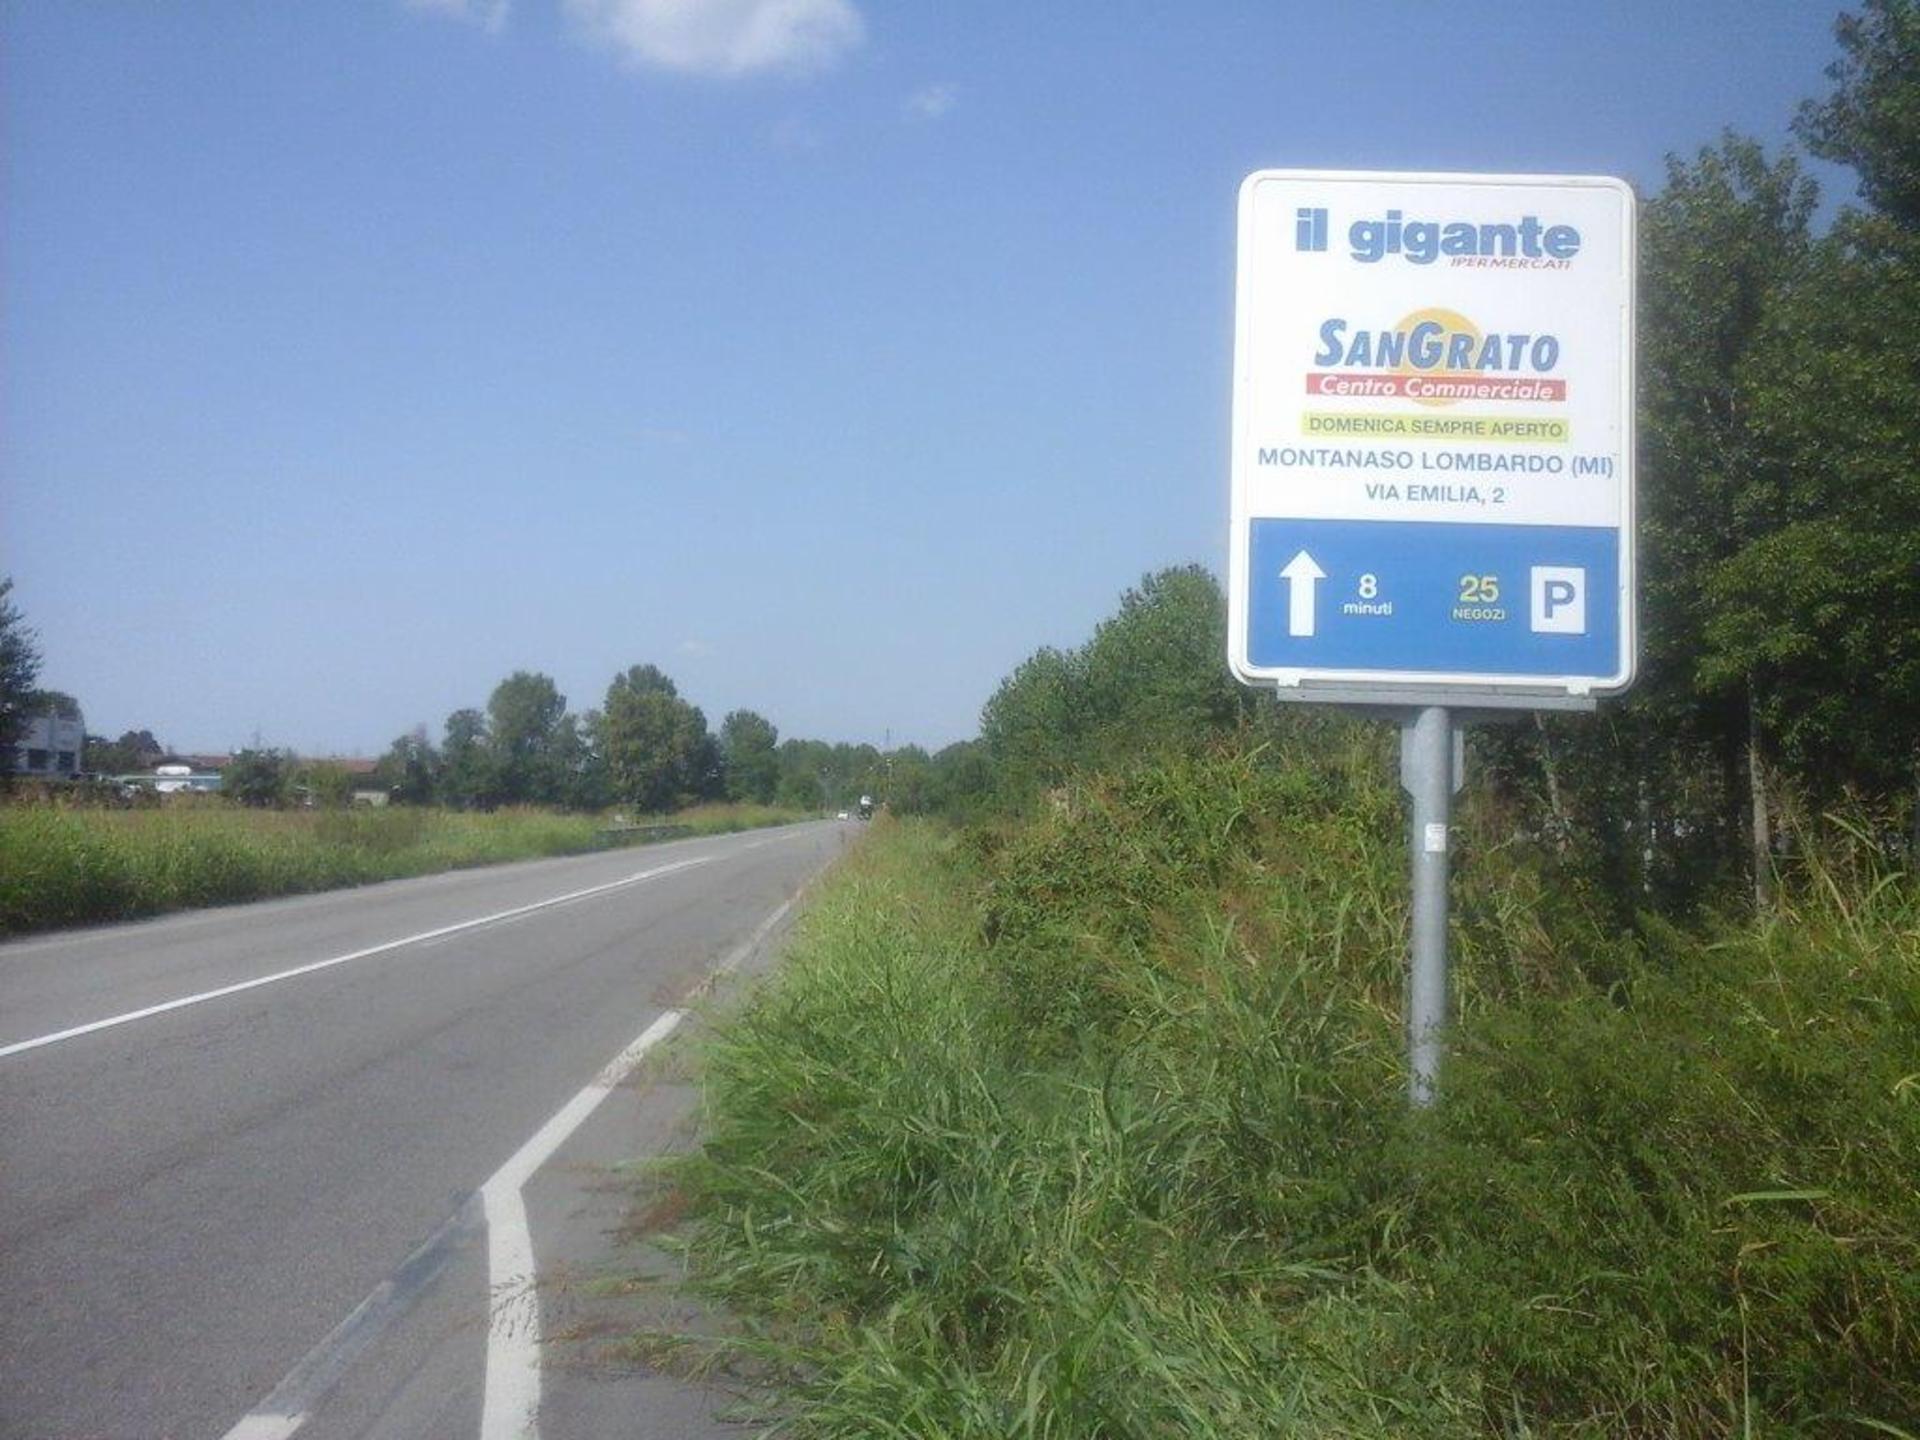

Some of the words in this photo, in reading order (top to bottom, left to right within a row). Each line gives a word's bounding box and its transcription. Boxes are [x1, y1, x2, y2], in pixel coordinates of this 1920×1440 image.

[1296, 208, 1328, 251] il
[1349, 210, 1581, 264] gigante
[1450, 257, 1571, 270] IPERMERCATI
[1320, 376, 1396, 396] Centro
[1405, 378, 1553, 400] Commerciale
[1310, 417, 1405, 435] DOMENICA
[1411, 419, 1485, 436] SEMPRE
[1490, 422, 1562, 438] APERTO
[1258, 448, 1413, 470] MONTANASO
[1422, 451, 1563, 473] LOMBARDO
[1572, 455, 1614, 479] (MI)
[1366, 484, 1400, 501] VIA
[1407, 485, 1486, 505] EMILIA,
[1492, 487, 1505, 503] 2
[1358, 574, 1378, 599] 8
[1460, 575, 1499, 602] 25
[1343, 600, 1392, 616] minuti
[1543, 580, 1576, 619] P
[1452, 607, 1505, 621] NEGOZI
